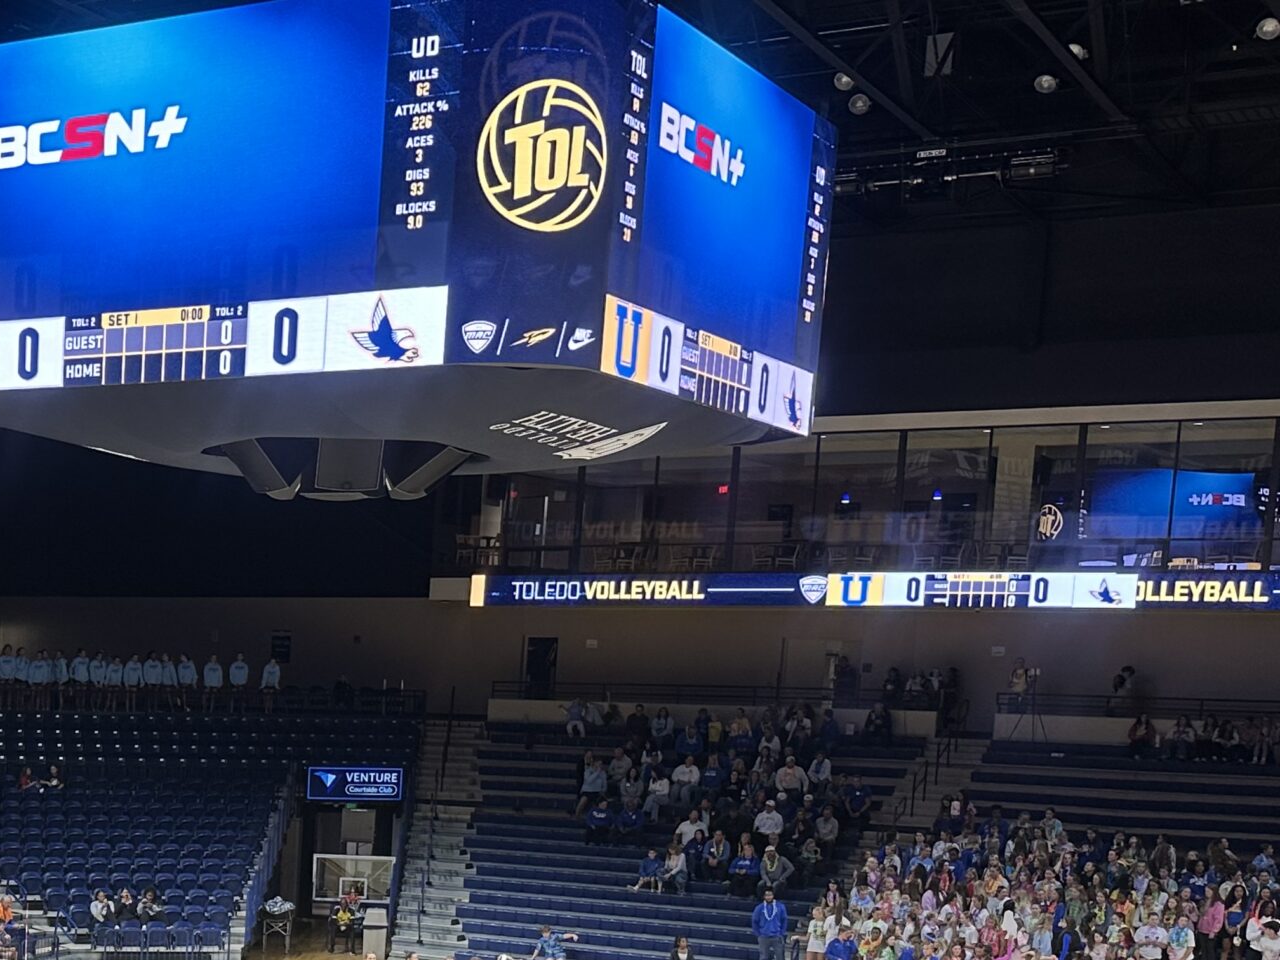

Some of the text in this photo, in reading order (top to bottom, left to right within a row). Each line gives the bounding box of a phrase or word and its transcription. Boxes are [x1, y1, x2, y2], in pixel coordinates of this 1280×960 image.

[411, 35, 440, 58] UD
[409, 67, 439, 82] KILLS
[631, 50, 648, 79] TOL
[416, 82, 431, 97] 62
[395, 100, 449, 117] ATTACK %
[405, 134, 434, 148] ACES
[659, 101, 745, 187] BCSN+
[415, 149, 423, 163] 3
[504, 120, 589, 200] TOL
[405, 168, 430, 181] DIGS
[410, 182, 424, 196] 93
[395, 200, 436, 215] BLOCKS
[108, 314, 130, 327] SET
[65, 335, 103, 350] GUEST
[220, 319, 233, 345] 0
[273, 307, 299, 365] 0
[465, 331, 491, 340] MAC
[616, 301, 643, 380] U
[18, 327, 40, 381] 0
[219, 349, 231, 375] 0
[659, 325, 672, 382] 0
[65, 363, 101, 379] HOME
[758, 363, 770, 414] 0
[512, 411, 619, 442] HEALTH
[511, 580, 705, 600] TOLEDO VOLLEYBALL
[841, 576, 871, 605] U
[906, 577, 920, 602] 0
[1034, 577, 1049, 603] 0
[346, 772, 398, 783] VENTURE
[349, 785, 393, 794] Courtside Club
